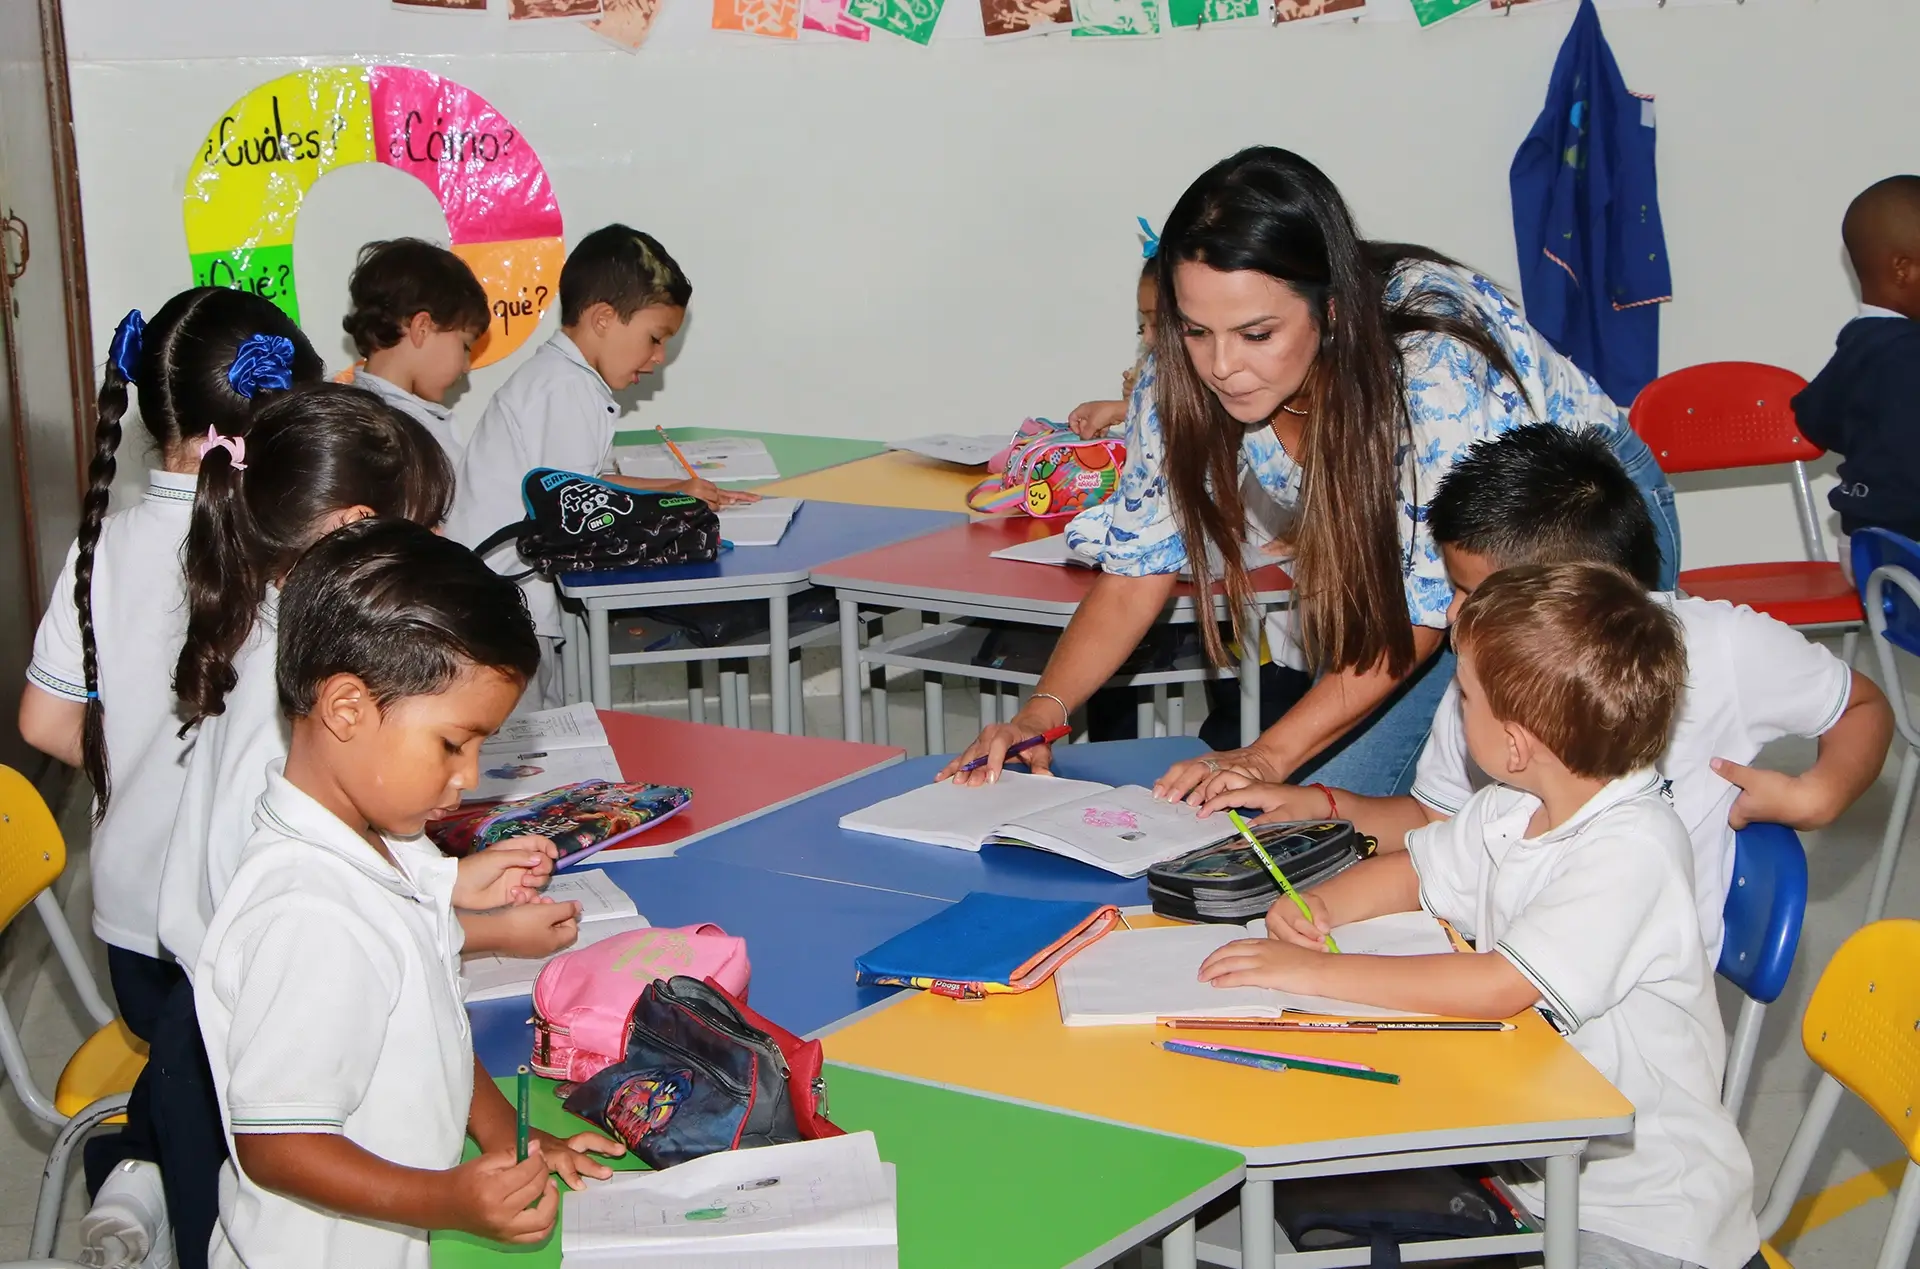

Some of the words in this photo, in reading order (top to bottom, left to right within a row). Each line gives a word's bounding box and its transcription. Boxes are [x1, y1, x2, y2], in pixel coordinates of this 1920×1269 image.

[204, 96, 347, 167] ¿Cuáles?
[493, 286, 549, 336] qué?
[543, 472, 574, 489] GAM
